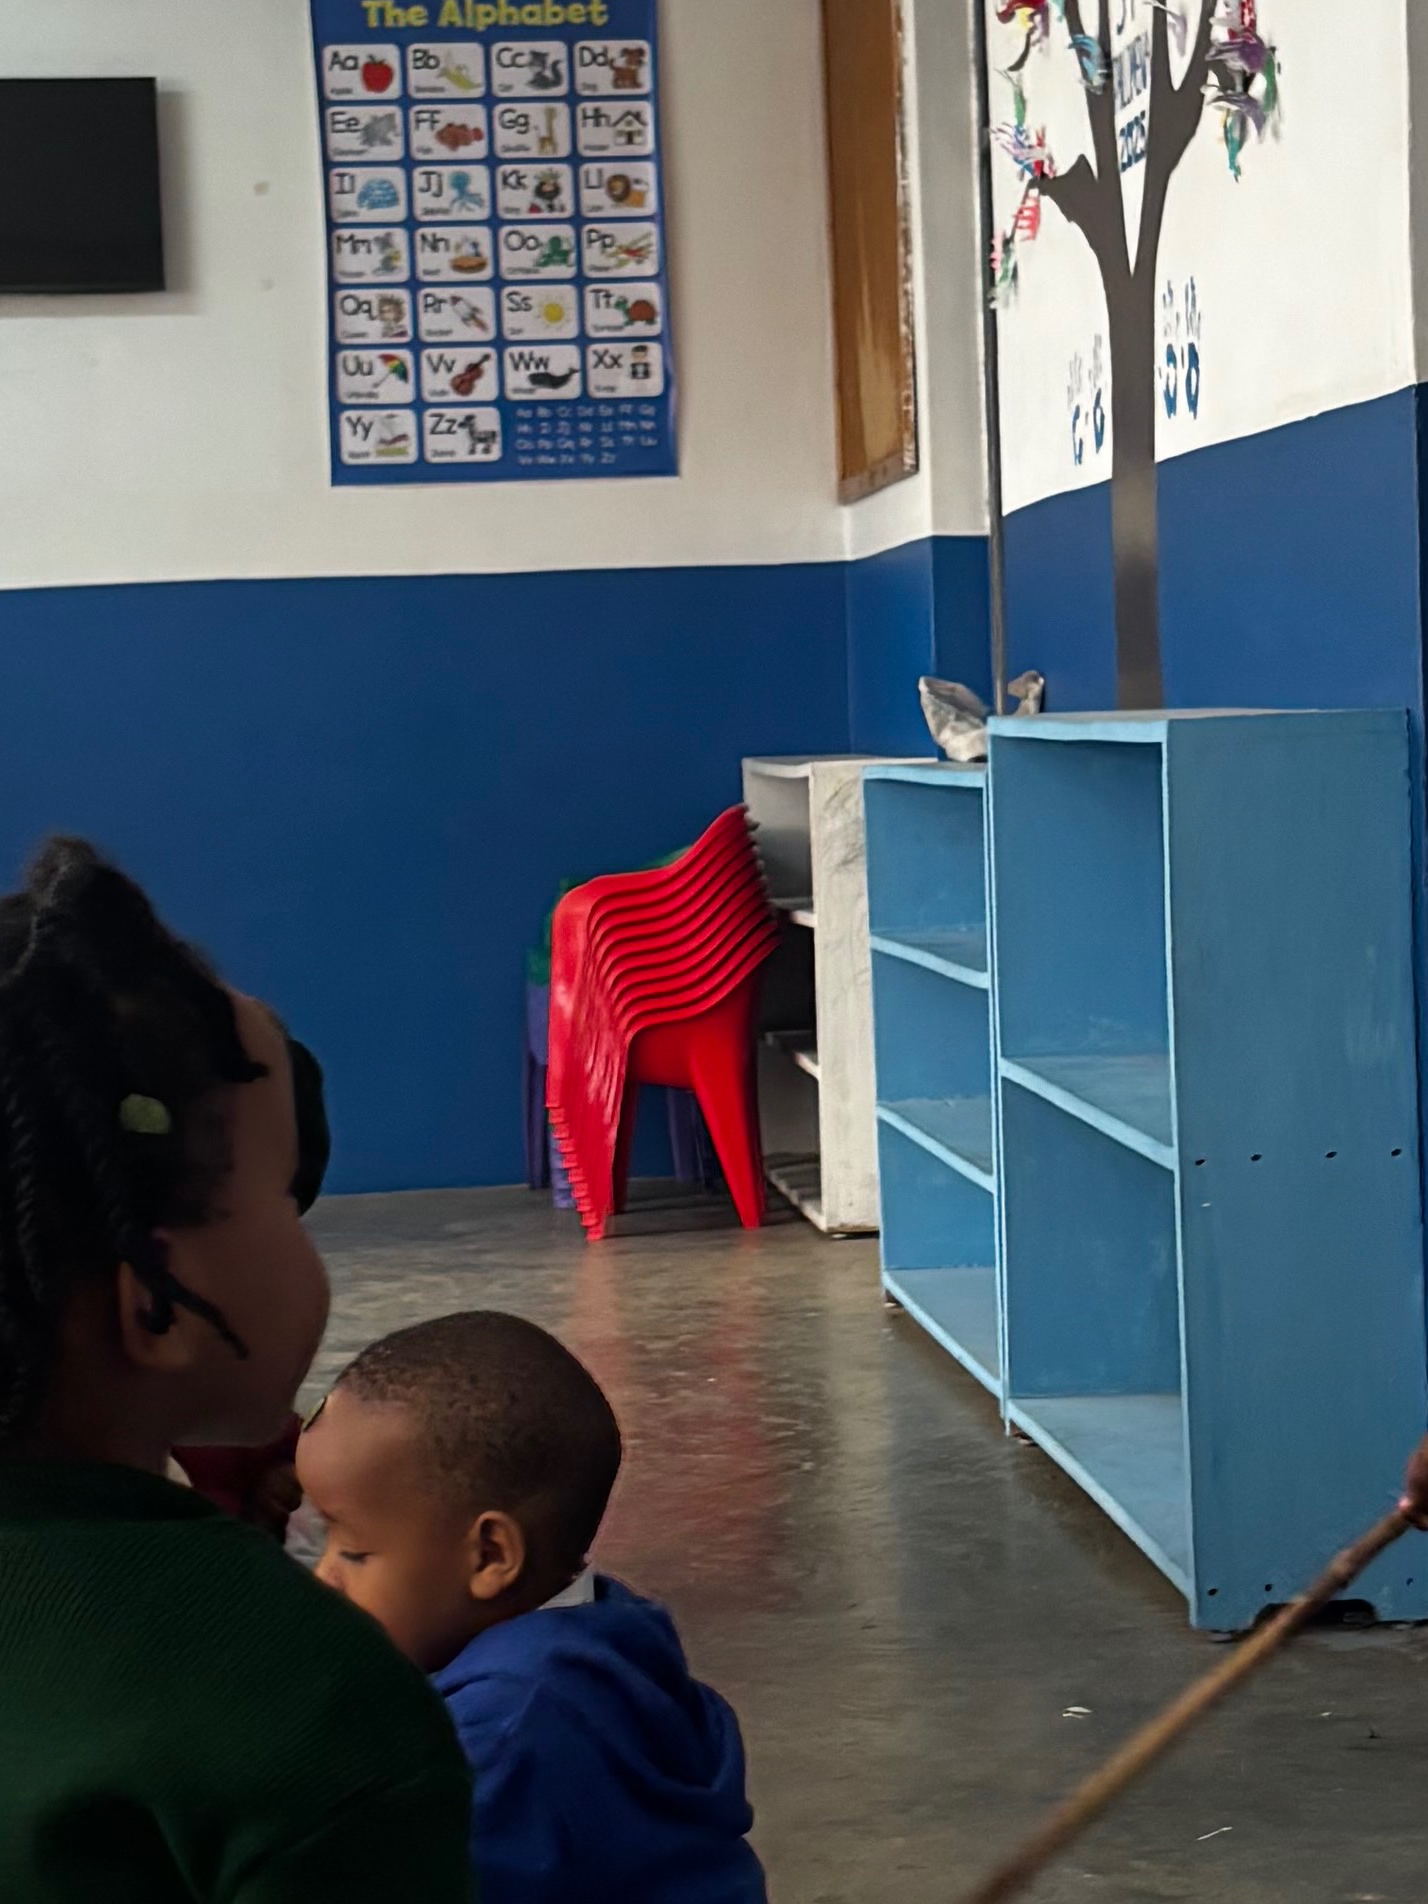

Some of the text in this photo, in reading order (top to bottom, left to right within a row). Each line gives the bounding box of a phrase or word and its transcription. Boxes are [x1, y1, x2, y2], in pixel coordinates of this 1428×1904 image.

[328, 46, 608, 71] Aa Bb Cc Dd
[330, 111, 361, 133] Ee
[499, 108, 530, 135] Gg
[581, 106, 612, 127] Hh
[418, 171, 443, 197] Jj
[501, 169, 528, 191] Kk
[335, 228, 616, 254] Mm Nn Oo Pp
[506, 290, 533, 312] Ss
[589, 288, 614, 309] Tt
[342, 348, 623, 376] Uu Vv Ww Xx
[345, 412, 457, 441] Yy Zz
